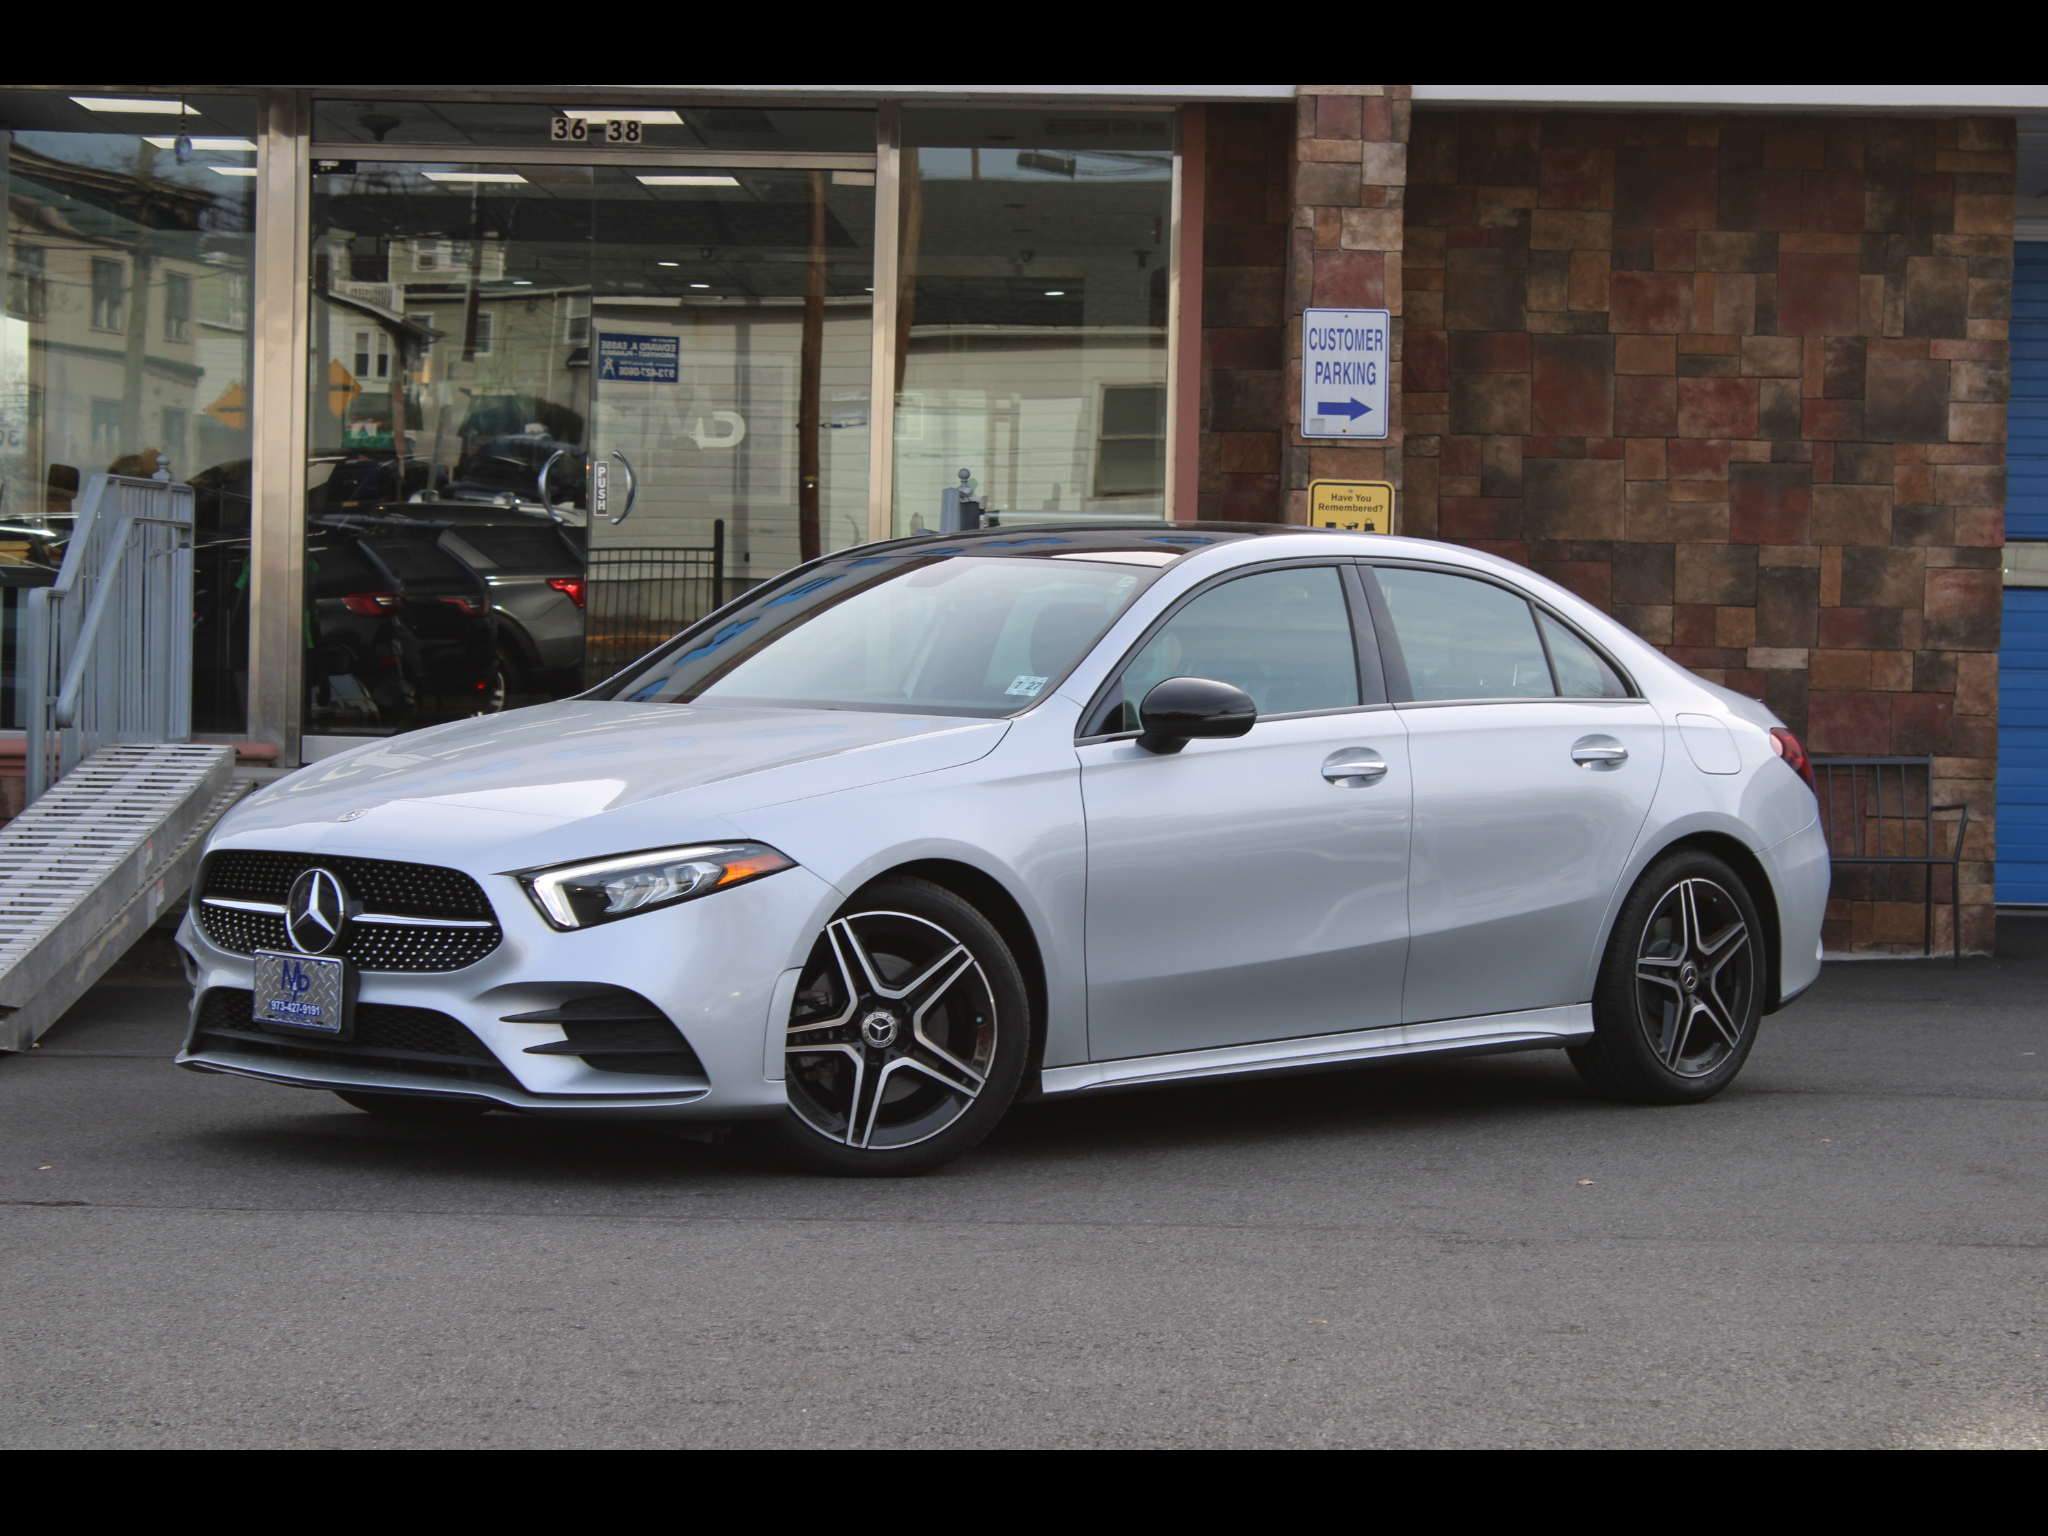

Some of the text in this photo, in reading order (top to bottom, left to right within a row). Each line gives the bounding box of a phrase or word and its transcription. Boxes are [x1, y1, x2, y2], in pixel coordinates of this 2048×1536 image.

[1308, 327, 1384, 351] CUSTOMER
[1315, 361, 1377, 386] PARKING
[597, 466, 607, 511] PUSH
[1331, 493, 1372, 502] Have You
[1318, 503, 1384, 512] Remembered?
[1025, 681, 1043, 690] 27
[270, 1000, 321, 1015] 973-427-9191
